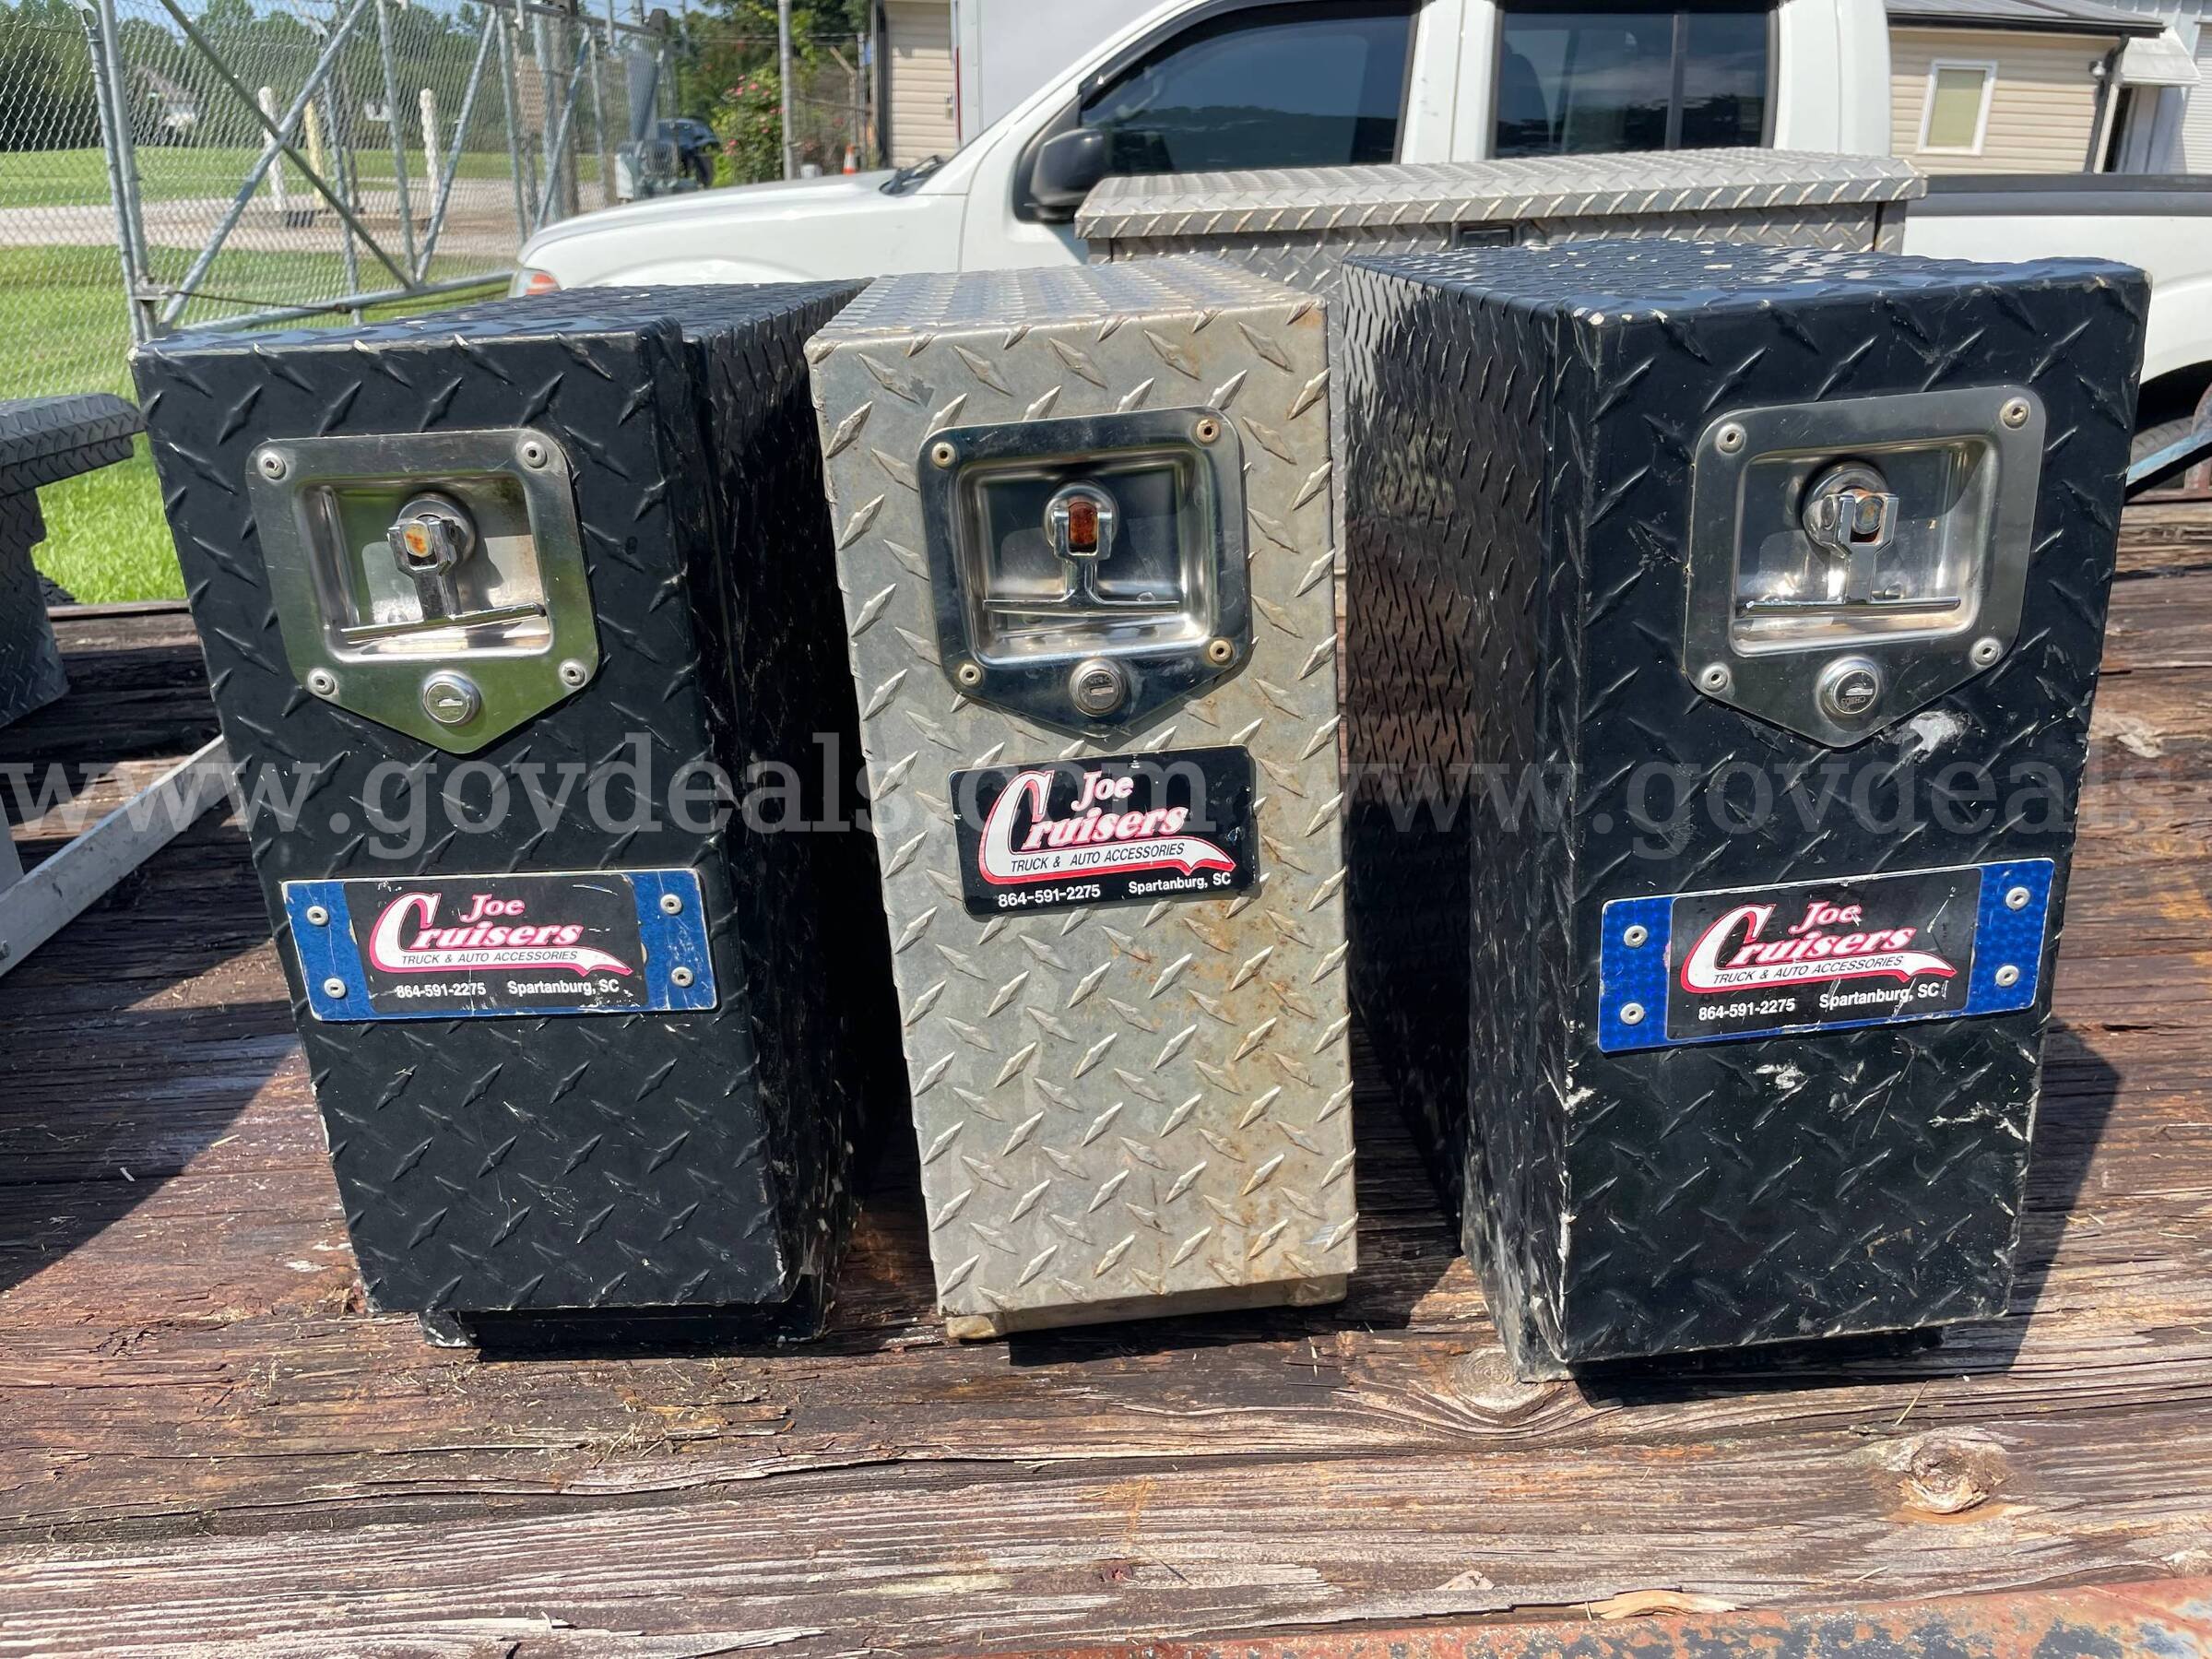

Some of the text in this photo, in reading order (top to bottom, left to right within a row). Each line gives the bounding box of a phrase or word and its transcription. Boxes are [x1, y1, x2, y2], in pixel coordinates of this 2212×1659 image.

[1071, 769, 1134, 812] Joe
[978, 769, 1189, 884] Cruisers
[1011, 842, 1186, 873] TRUCK & AUTO ACCESSORIES
[998, 872, 1232, 907] 864-591-2275 Spartanburg, SC
[459, 893, 526, 922] Joe
[1788, 900, 1862, 935] Joe
[369, 892, 584, 972] Cruisers
[1680, 903, 1918, 995] Cruisers
[401, 950, 579, 965] TRUCK & AUTO ACCESSORIES
[1712, 955, 1904, 985] TRUCK & AUTO ACCESSORIES
[396, 978, 620, 999] 864-591-2275 Spartanburg, SC
[1698, 982, 1939, 1021] 864-591-2275 Spartanburg, SC
